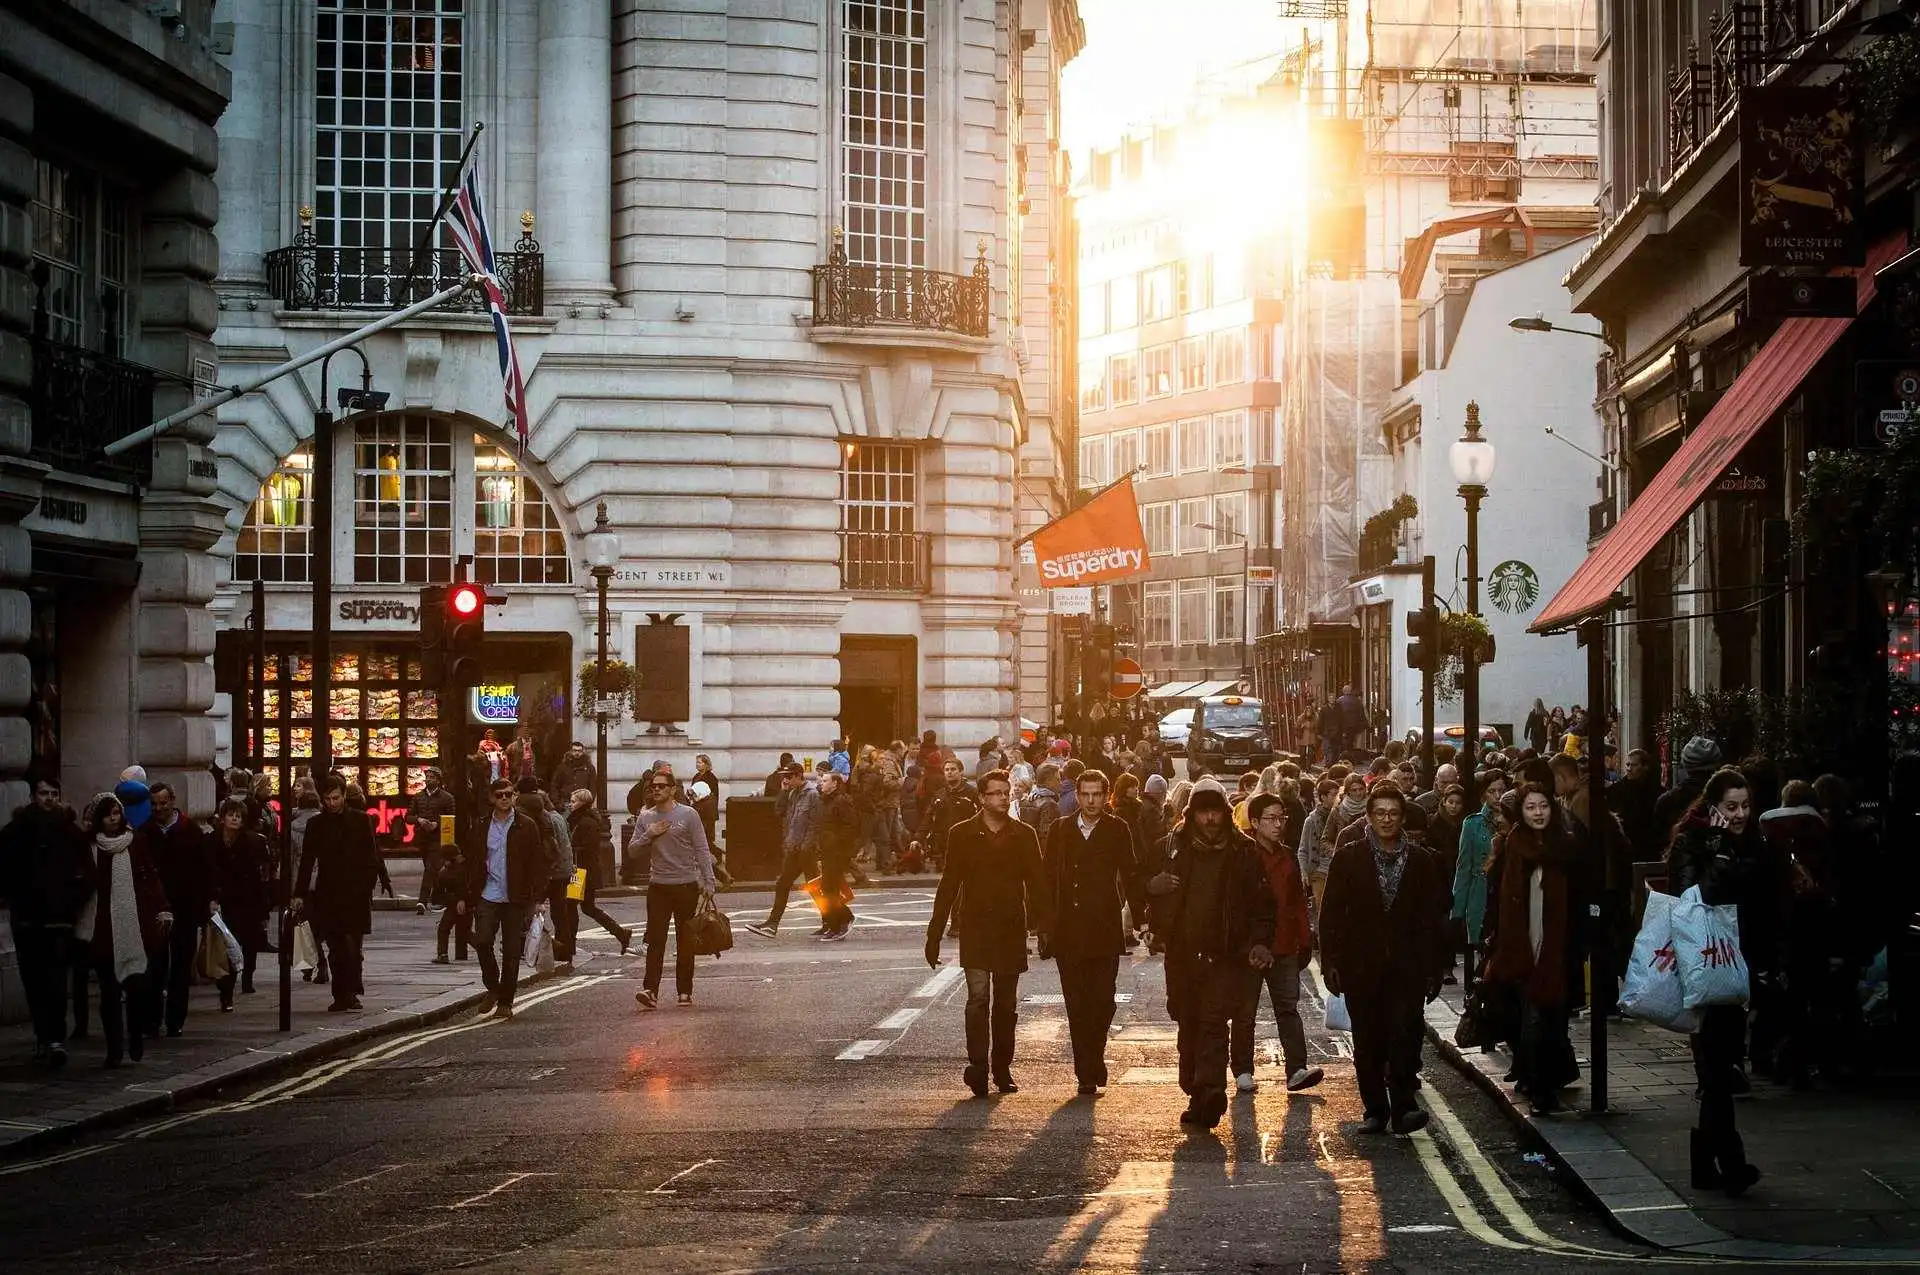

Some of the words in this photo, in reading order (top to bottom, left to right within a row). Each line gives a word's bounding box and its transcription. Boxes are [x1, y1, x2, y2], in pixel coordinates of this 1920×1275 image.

[1764, 236, 1844, 249] LEICESTER
[1784, 251, 1826, 262] ARMS
[1042, 546, 1142, 581] Superdry
[657, 571, 701, 581] STREET
[339, 600, 423, 625] Superdry
[479, 684, 516, 697] T-SHIRT
